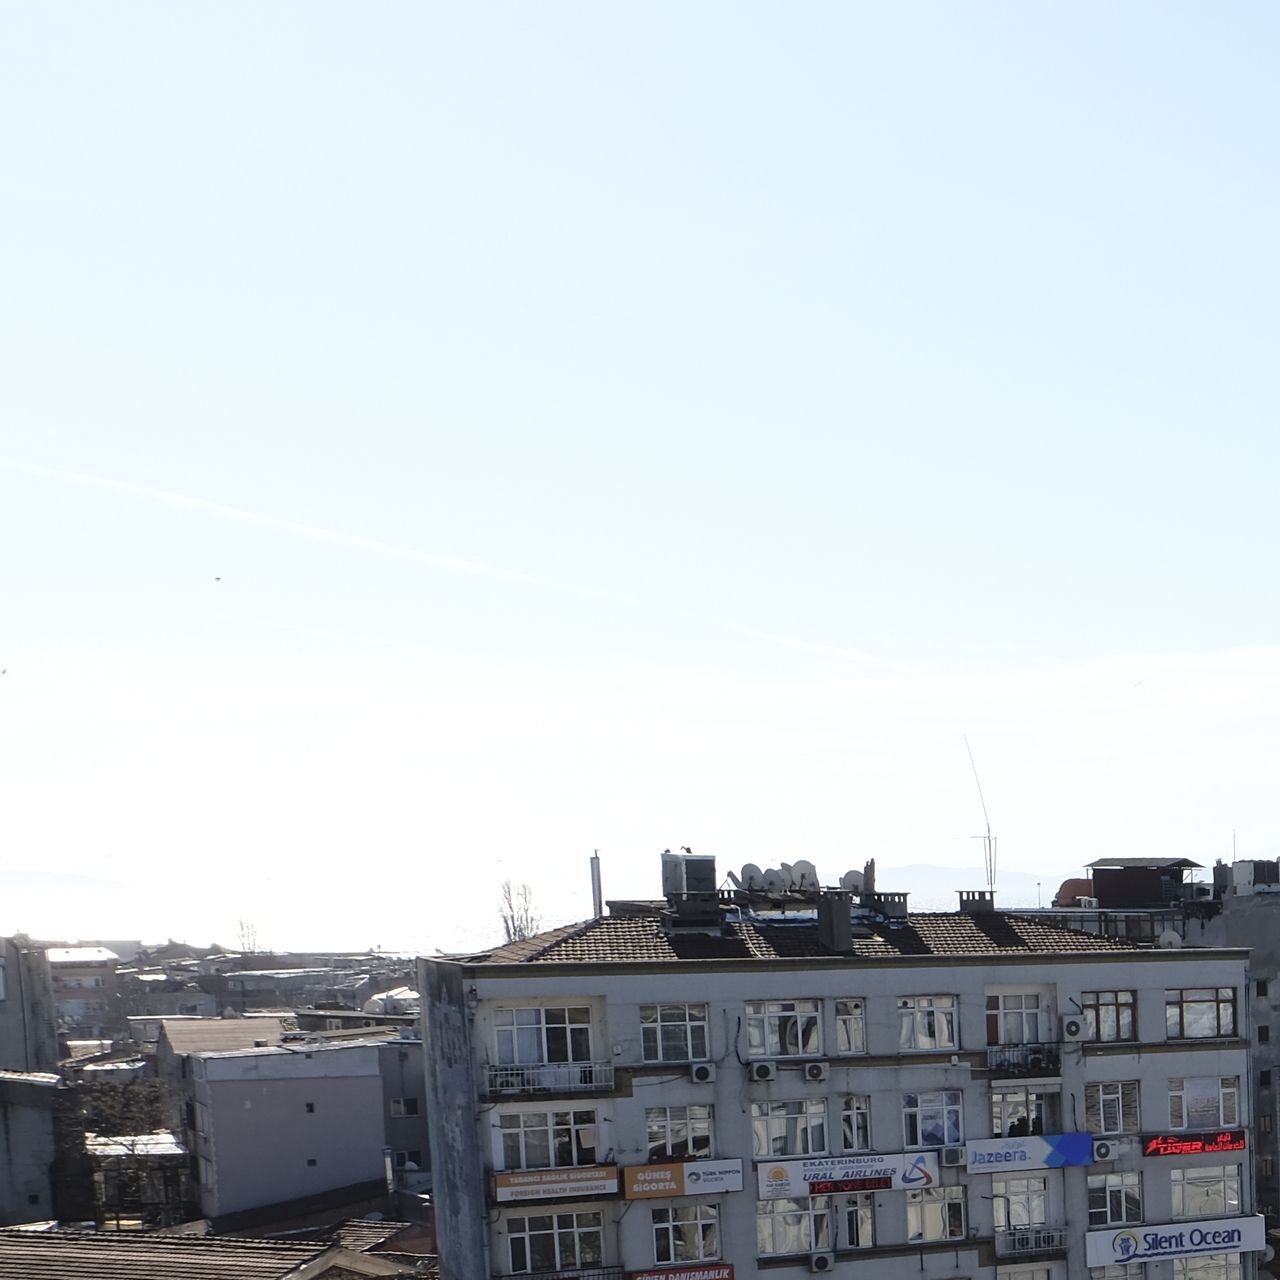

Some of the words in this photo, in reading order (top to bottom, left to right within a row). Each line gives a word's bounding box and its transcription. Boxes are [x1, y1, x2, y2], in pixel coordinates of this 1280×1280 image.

[802, 1157, 884, 1168] EKATERINBURG
[637, 1170, 673, 1181] GÜNEŞ
[803, 1172, 834, 1182] URAL
[842, 1168, 897, 1179] AIRLINES
[632, 1181, 677, 1193] SİGORTA
[1144, 1232, 1187, 1251] Silent
[1190, 1228, 1241, 1247] Ocean
